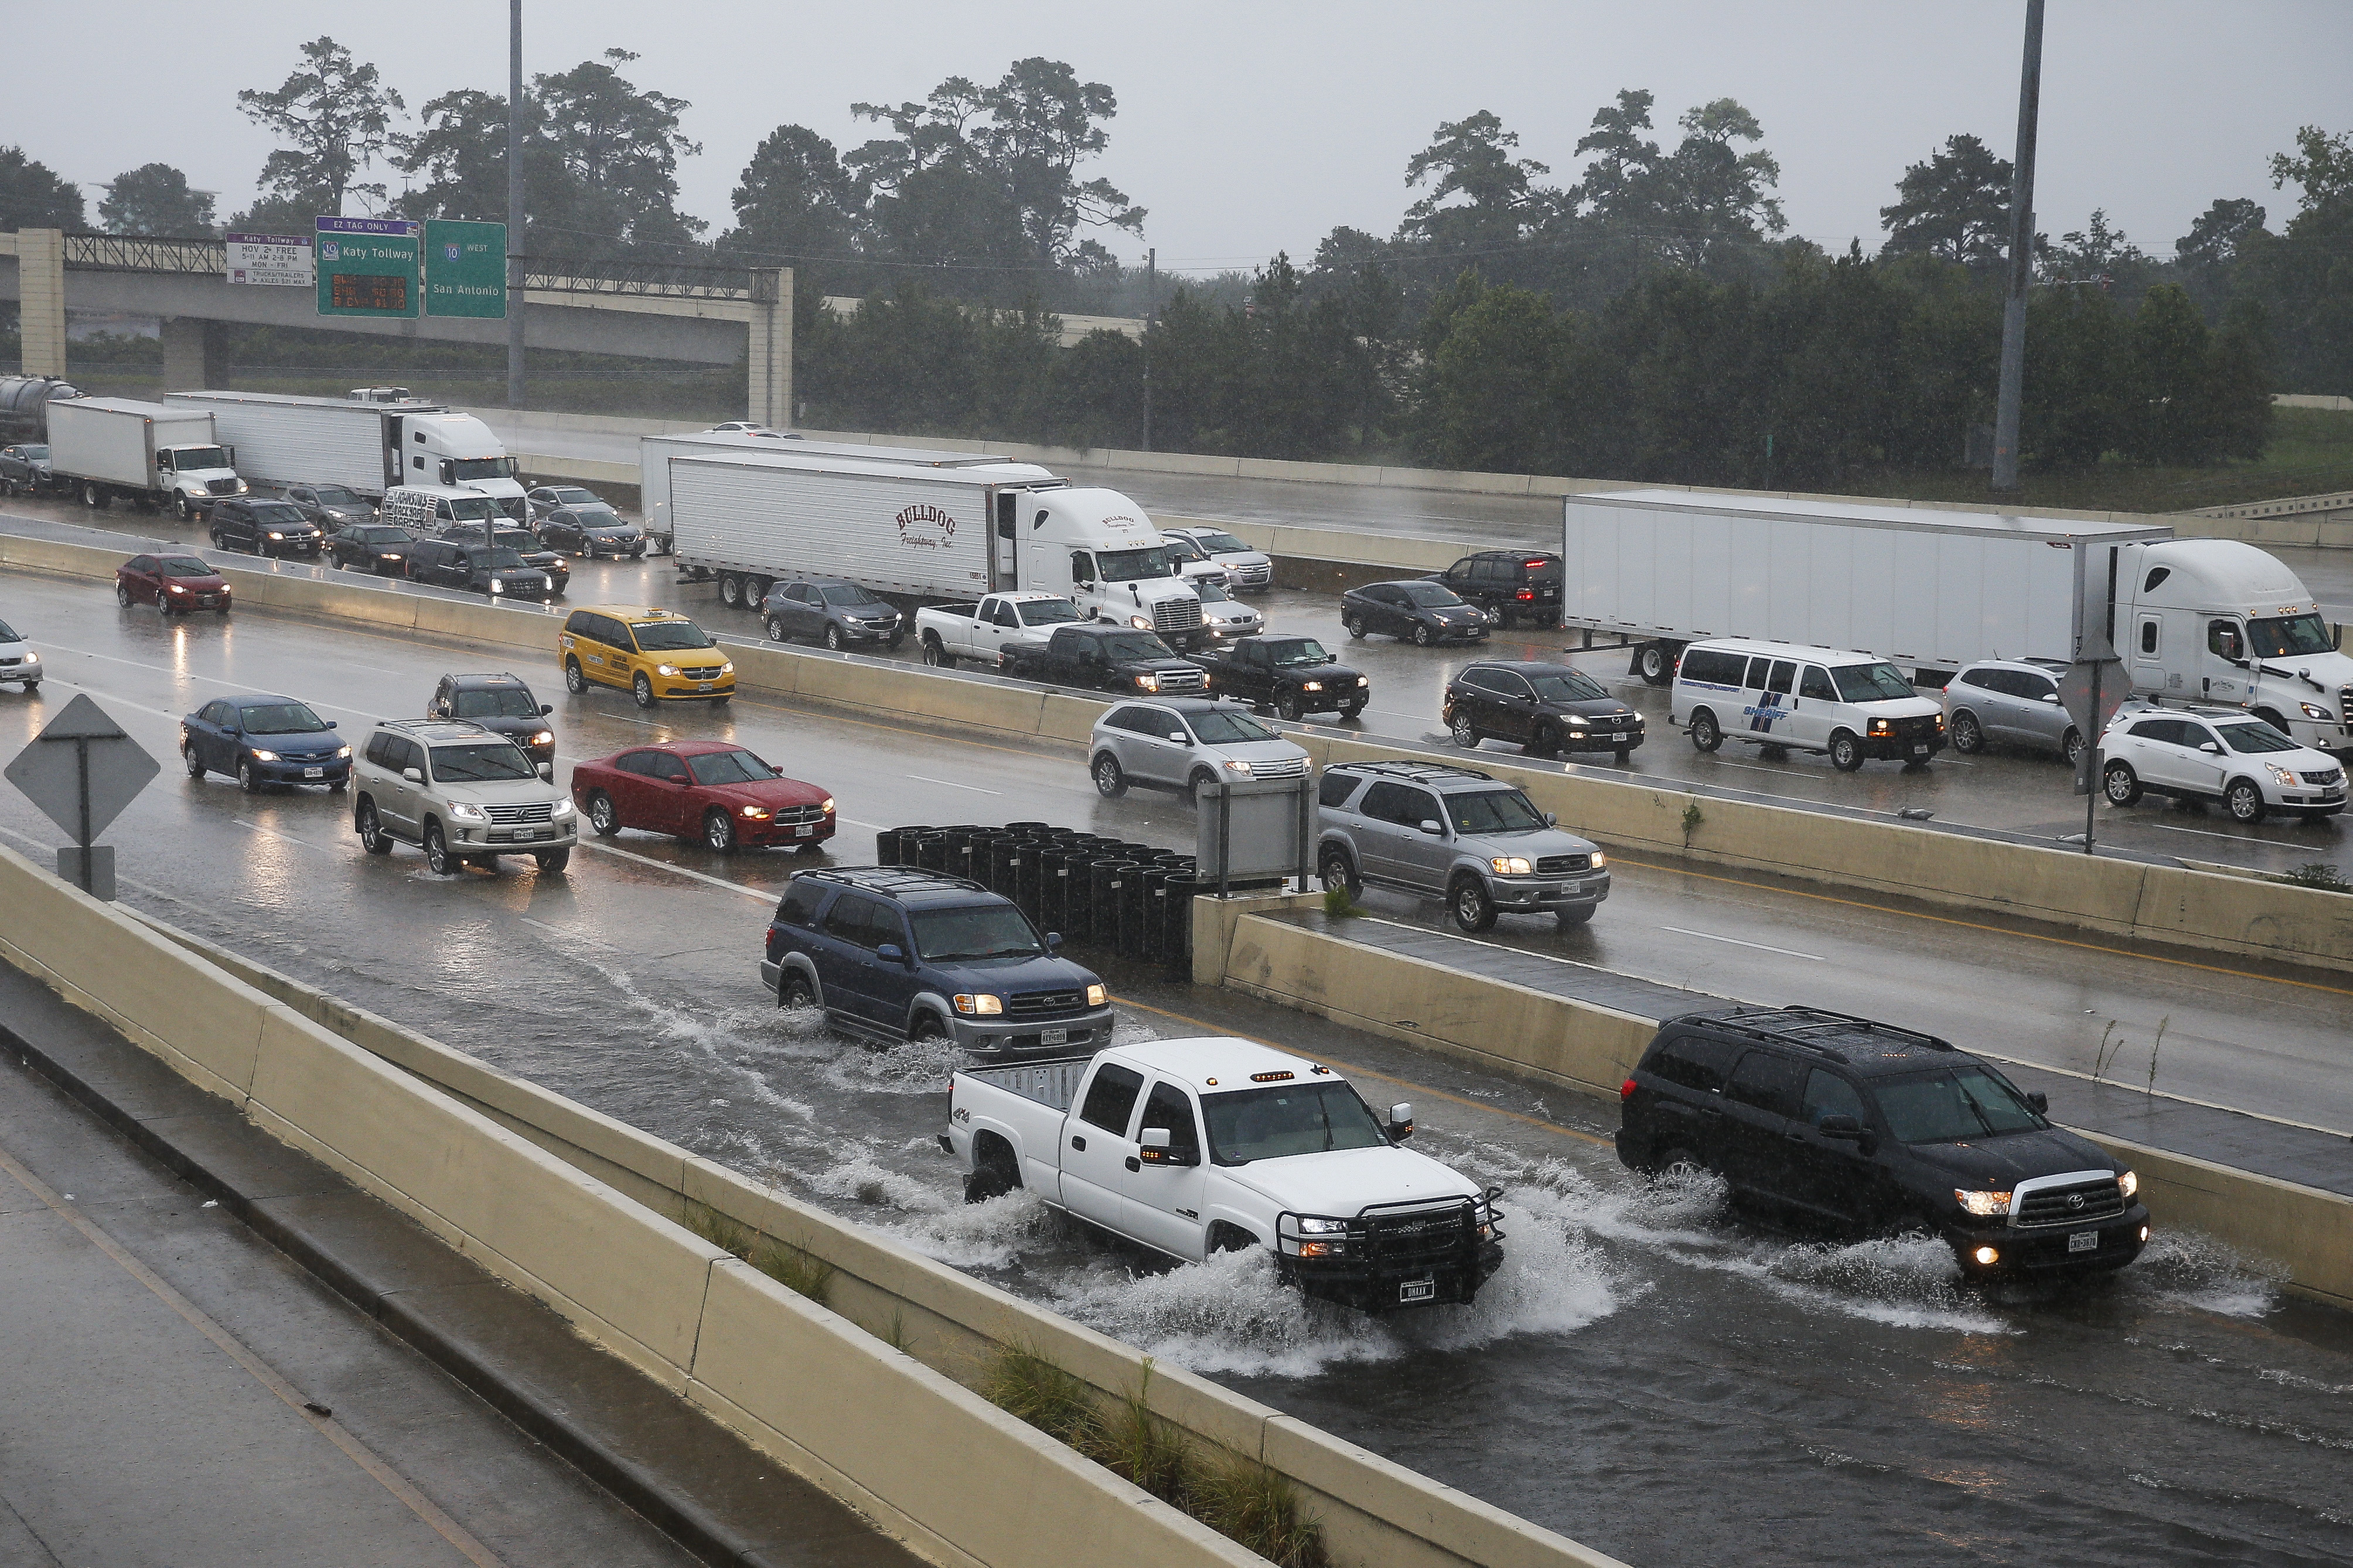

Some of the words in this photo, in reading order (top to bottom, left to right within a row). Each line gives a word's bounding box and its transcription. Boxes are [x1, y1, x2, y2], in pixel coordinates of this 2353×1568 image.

[267, 237, 294, 245] Tollway
[326, 244, 336, 252] 10
[448, 248, 458, 258] 10
[343, 247, 366, 259] Katy
[372, 248, 413, 262] Tollway
[434, 284, 452, 293] San
[458, 285, 499, 296] Antonio
[394, 516, 426, 530] GARDEN
[896, 505, 956, 537] BULLDOG
[1102, 516, 1134, 525] BULLDOG
[942, 537, 953, 549] Inc.
[1743, 706, 1788, 720] SHERIFF
[1409, 1286, 1426, 1296] DMAXX
